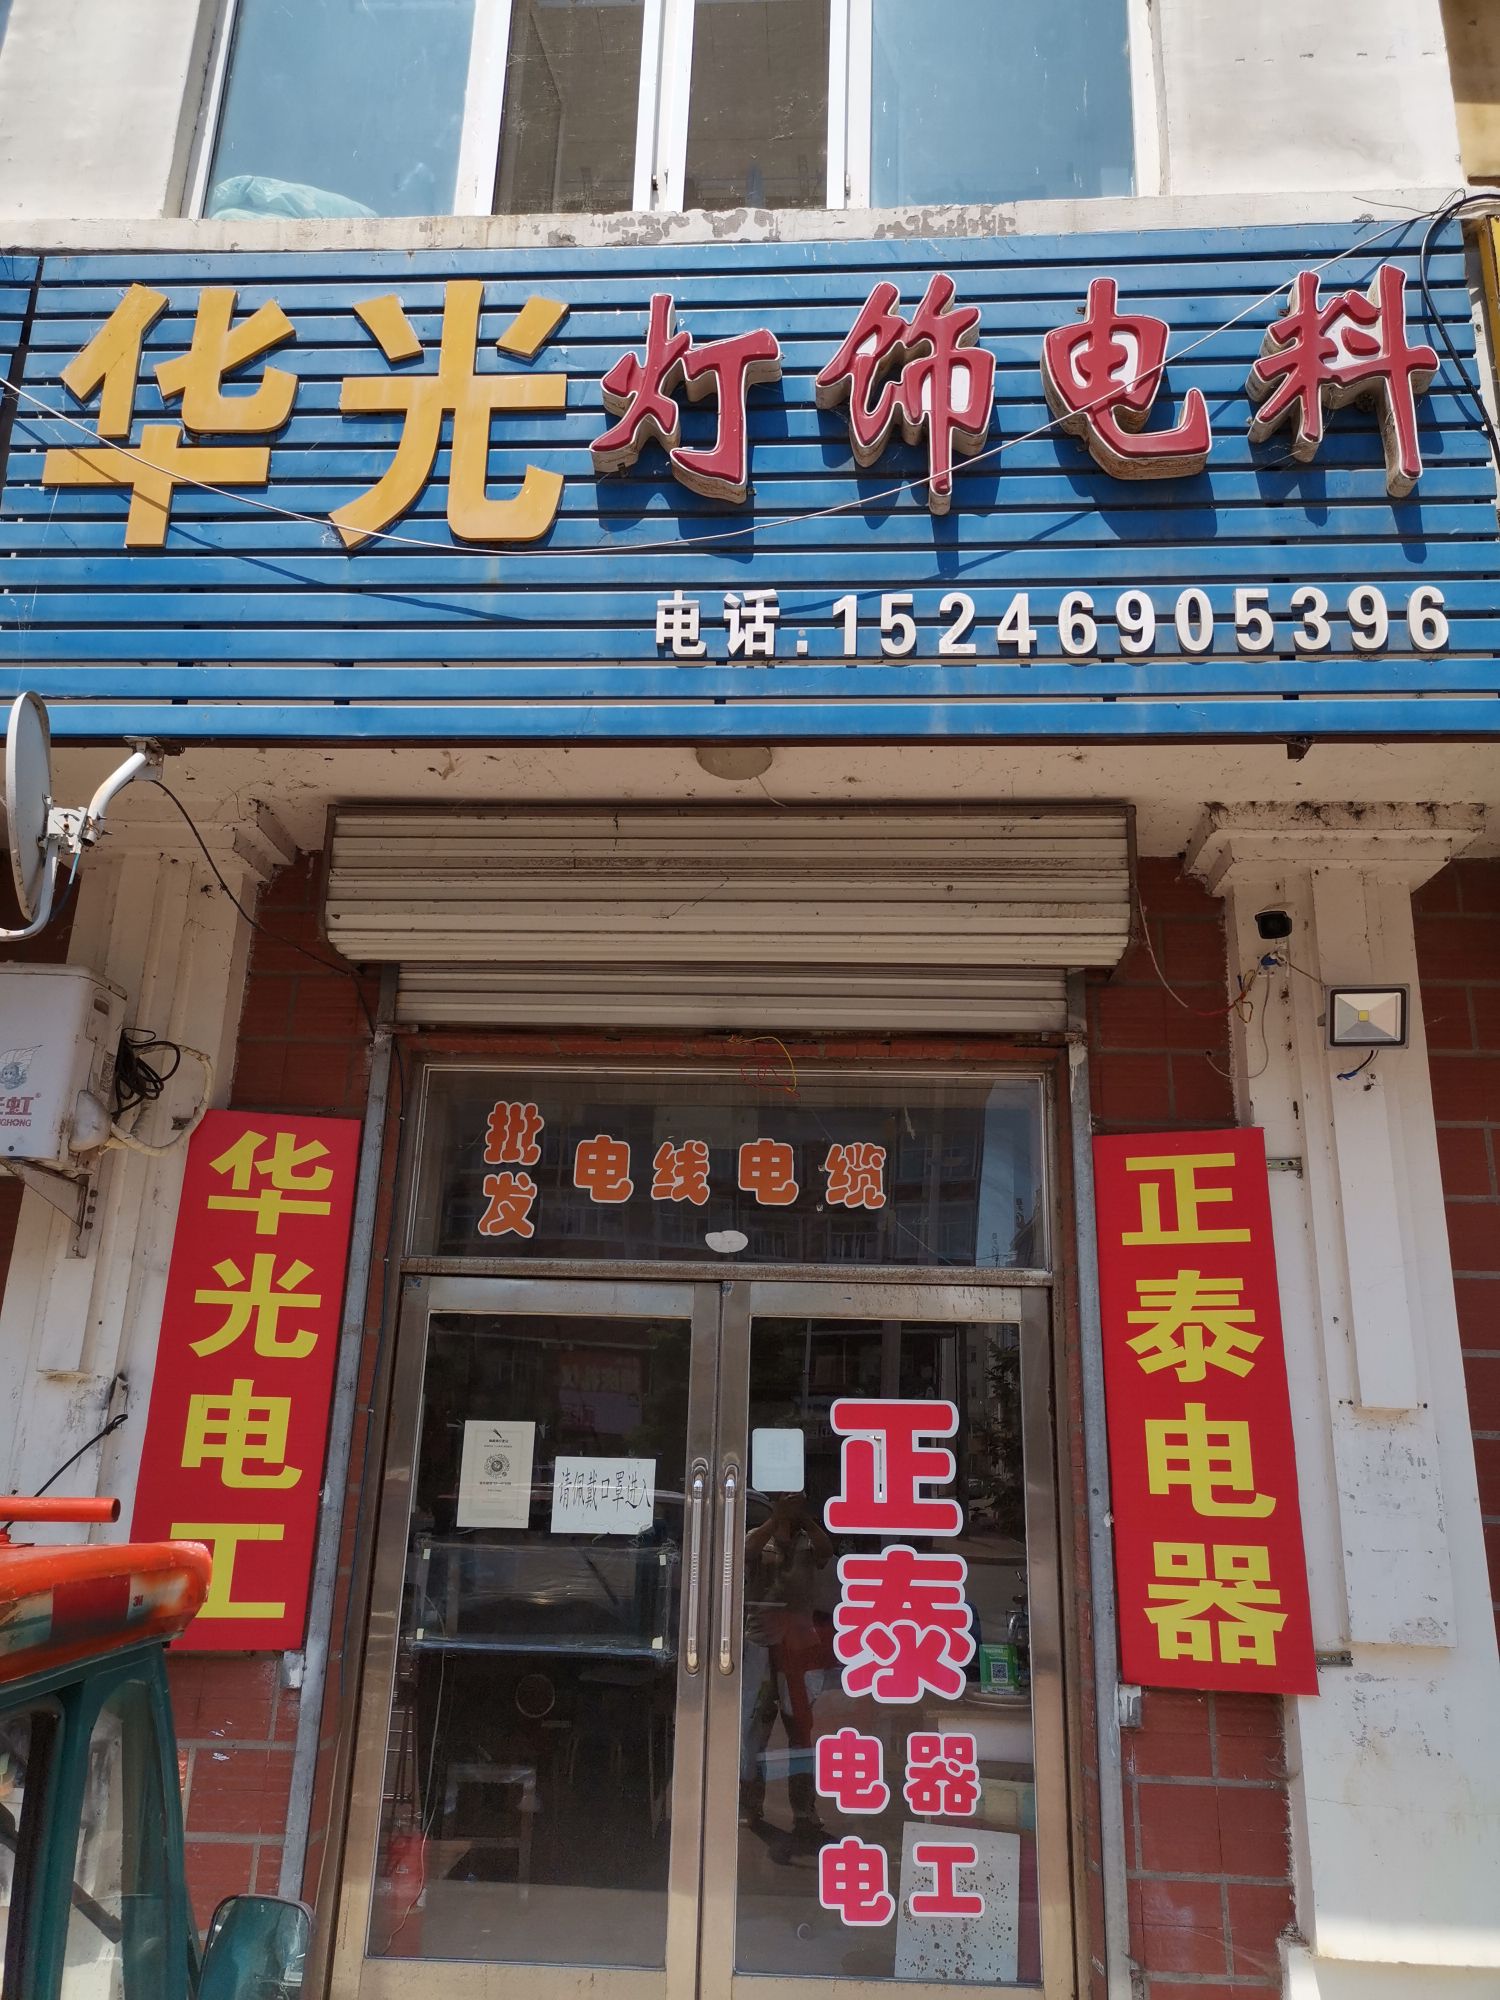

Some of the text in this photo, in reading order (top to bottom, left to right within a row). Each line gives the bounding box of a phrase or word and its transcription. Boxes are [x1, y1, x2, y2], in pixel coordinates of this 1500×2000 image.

[0, 1096, 34, 1116] 虹
[0, 1119, 32, 1127] GHONG
[477, 1101, 544, 1238] 批发
[170, 1130, 334, 1619] 华光电工
[1121, 1152, 1289, 1666] 正泰电器
[560, 1467, 652, 1513] 请佩戴口罩进入
